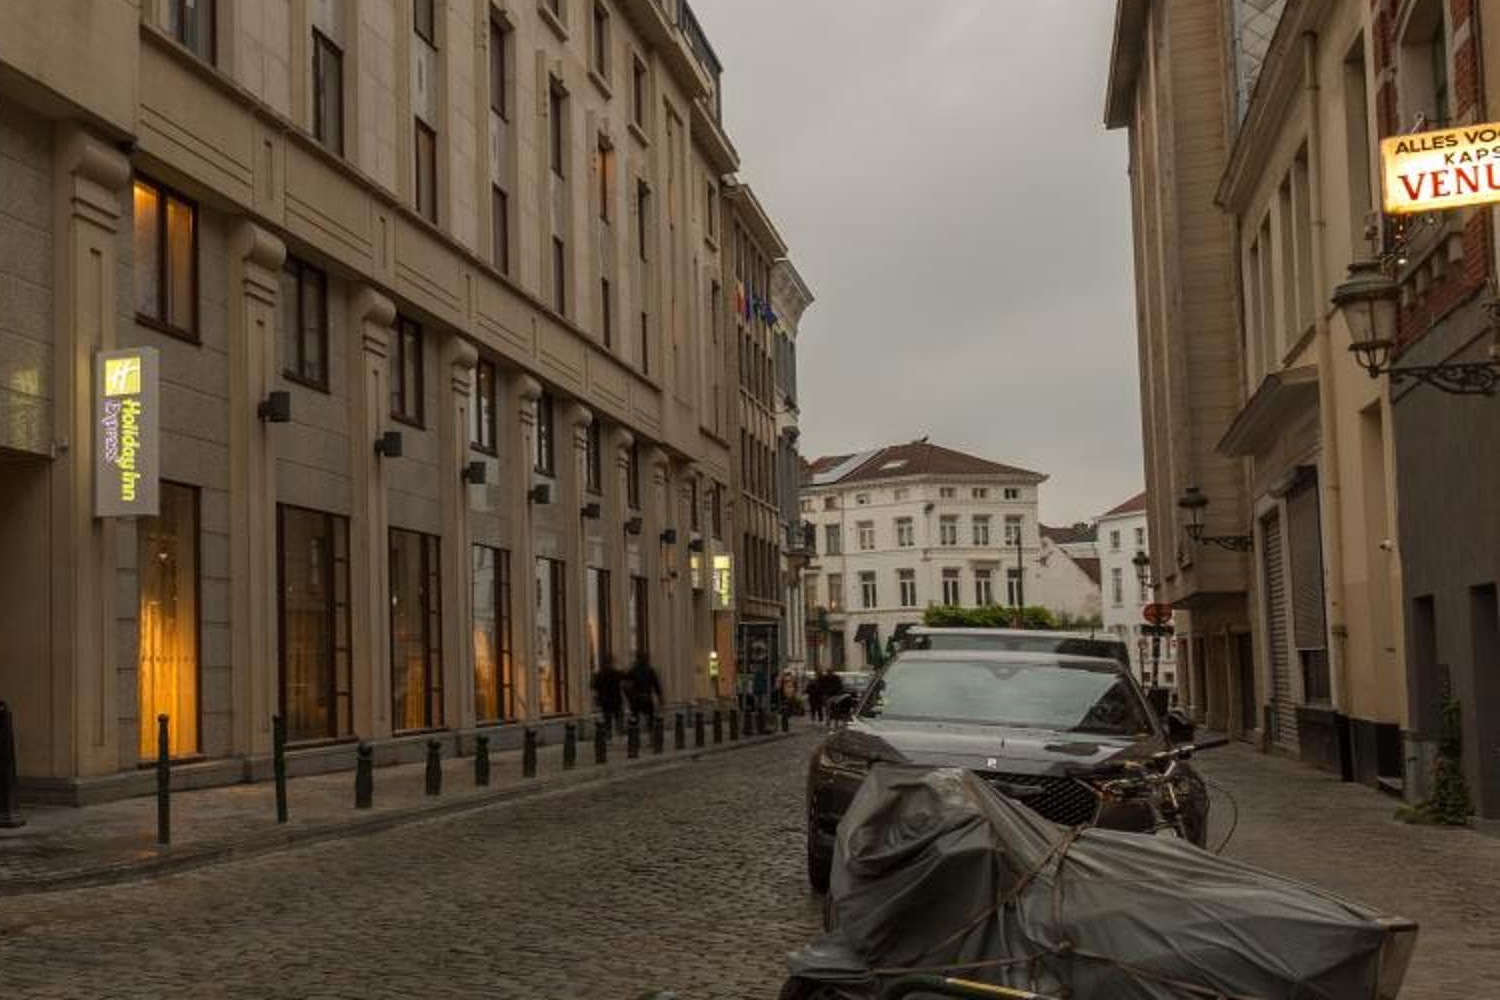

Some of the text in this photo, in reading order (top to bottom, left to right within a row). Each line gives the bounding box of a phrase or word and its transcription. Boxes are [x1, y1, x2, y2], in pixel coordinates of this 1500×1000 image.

[1395, 128, 1500, 155] ALLES VO
[121, 471, 141, 502] Inn
